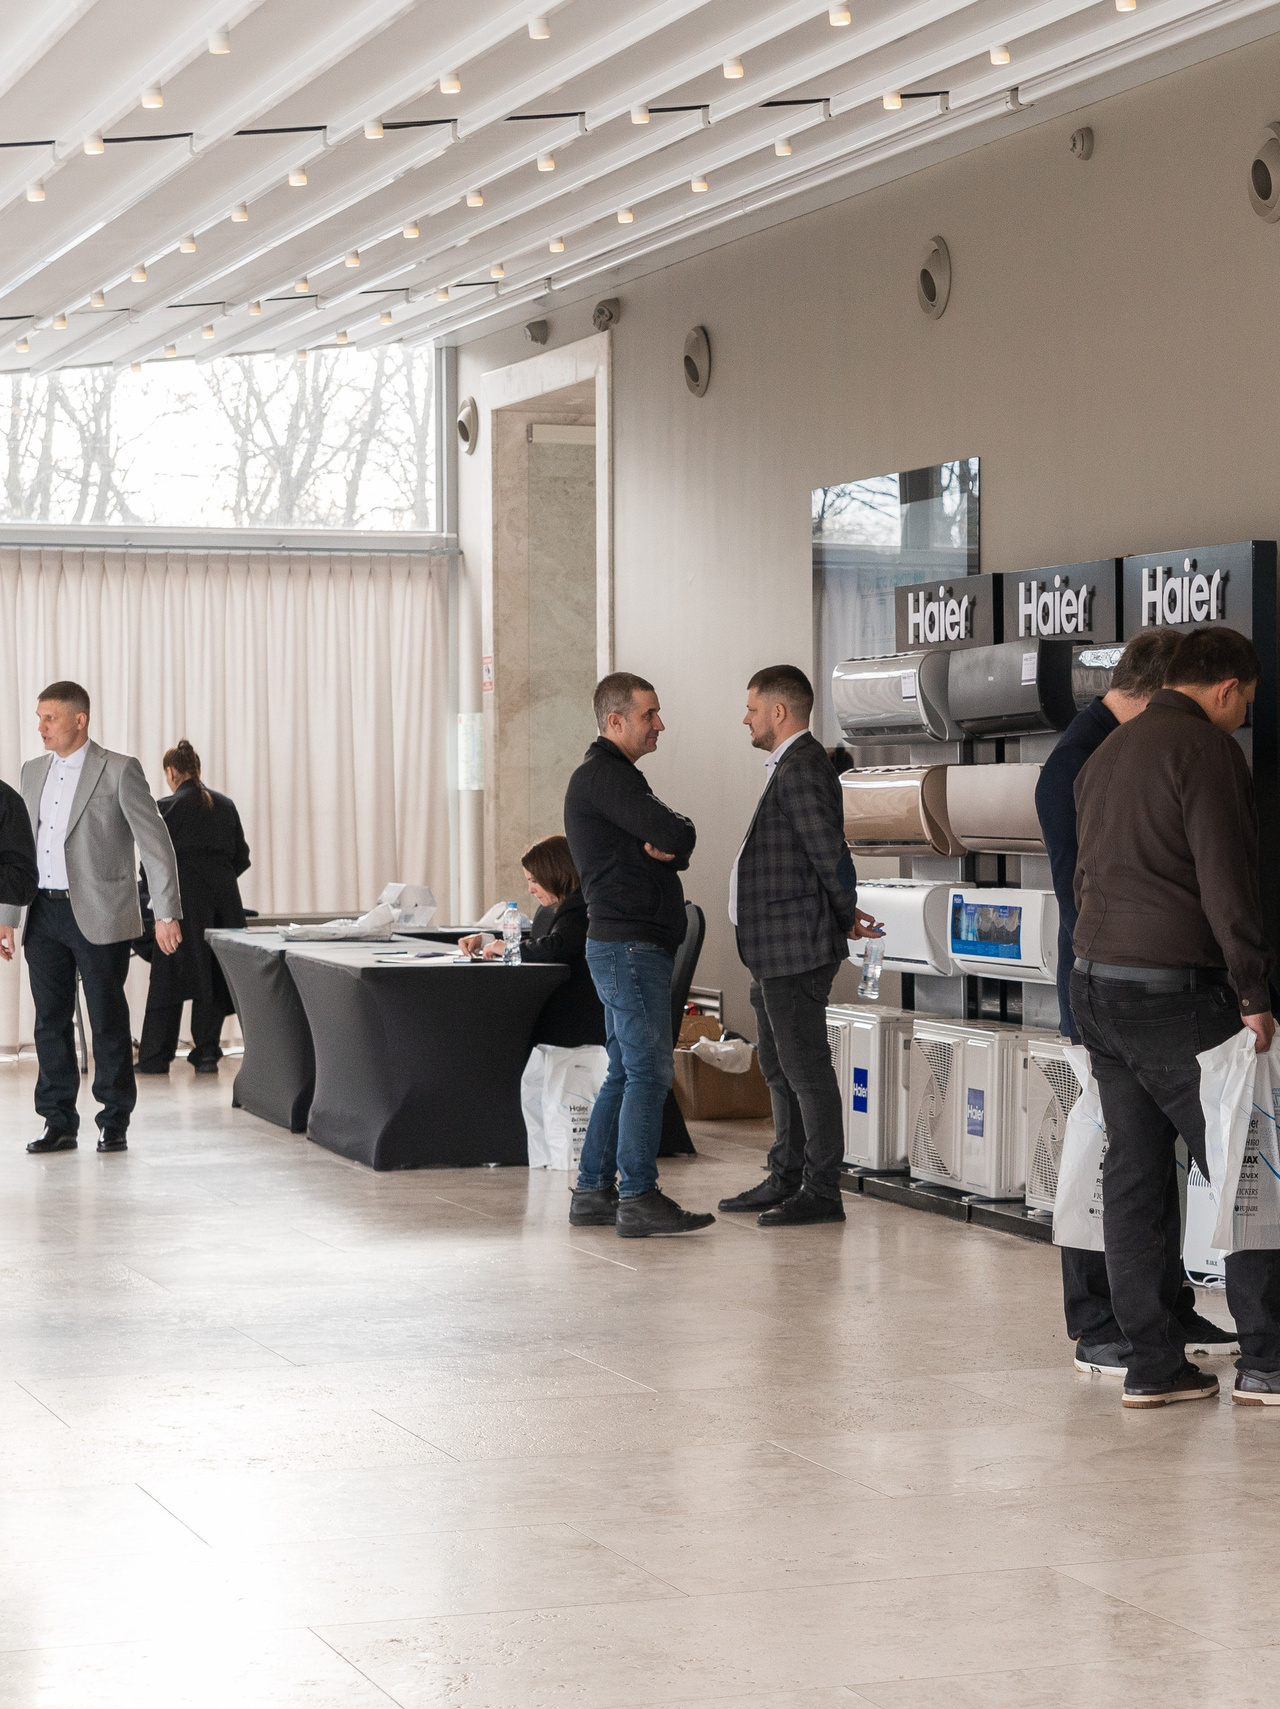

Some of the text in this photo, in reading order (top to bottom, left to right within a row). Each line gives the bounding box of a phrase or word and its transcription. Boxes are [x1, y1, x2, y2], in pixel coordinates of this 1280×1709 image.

[1141, 558, 1221, 627] Haier
[1018, 574, 1088, 638] Haier
[908, 586, 968, 645] Haier
[853, 1082, 868, 1098] Haier
[569, 1105, 588, 1113] Haier
[967, 1104, 984, 1121] Haier
[1239, 1172, 1259, 1180] OVEX
